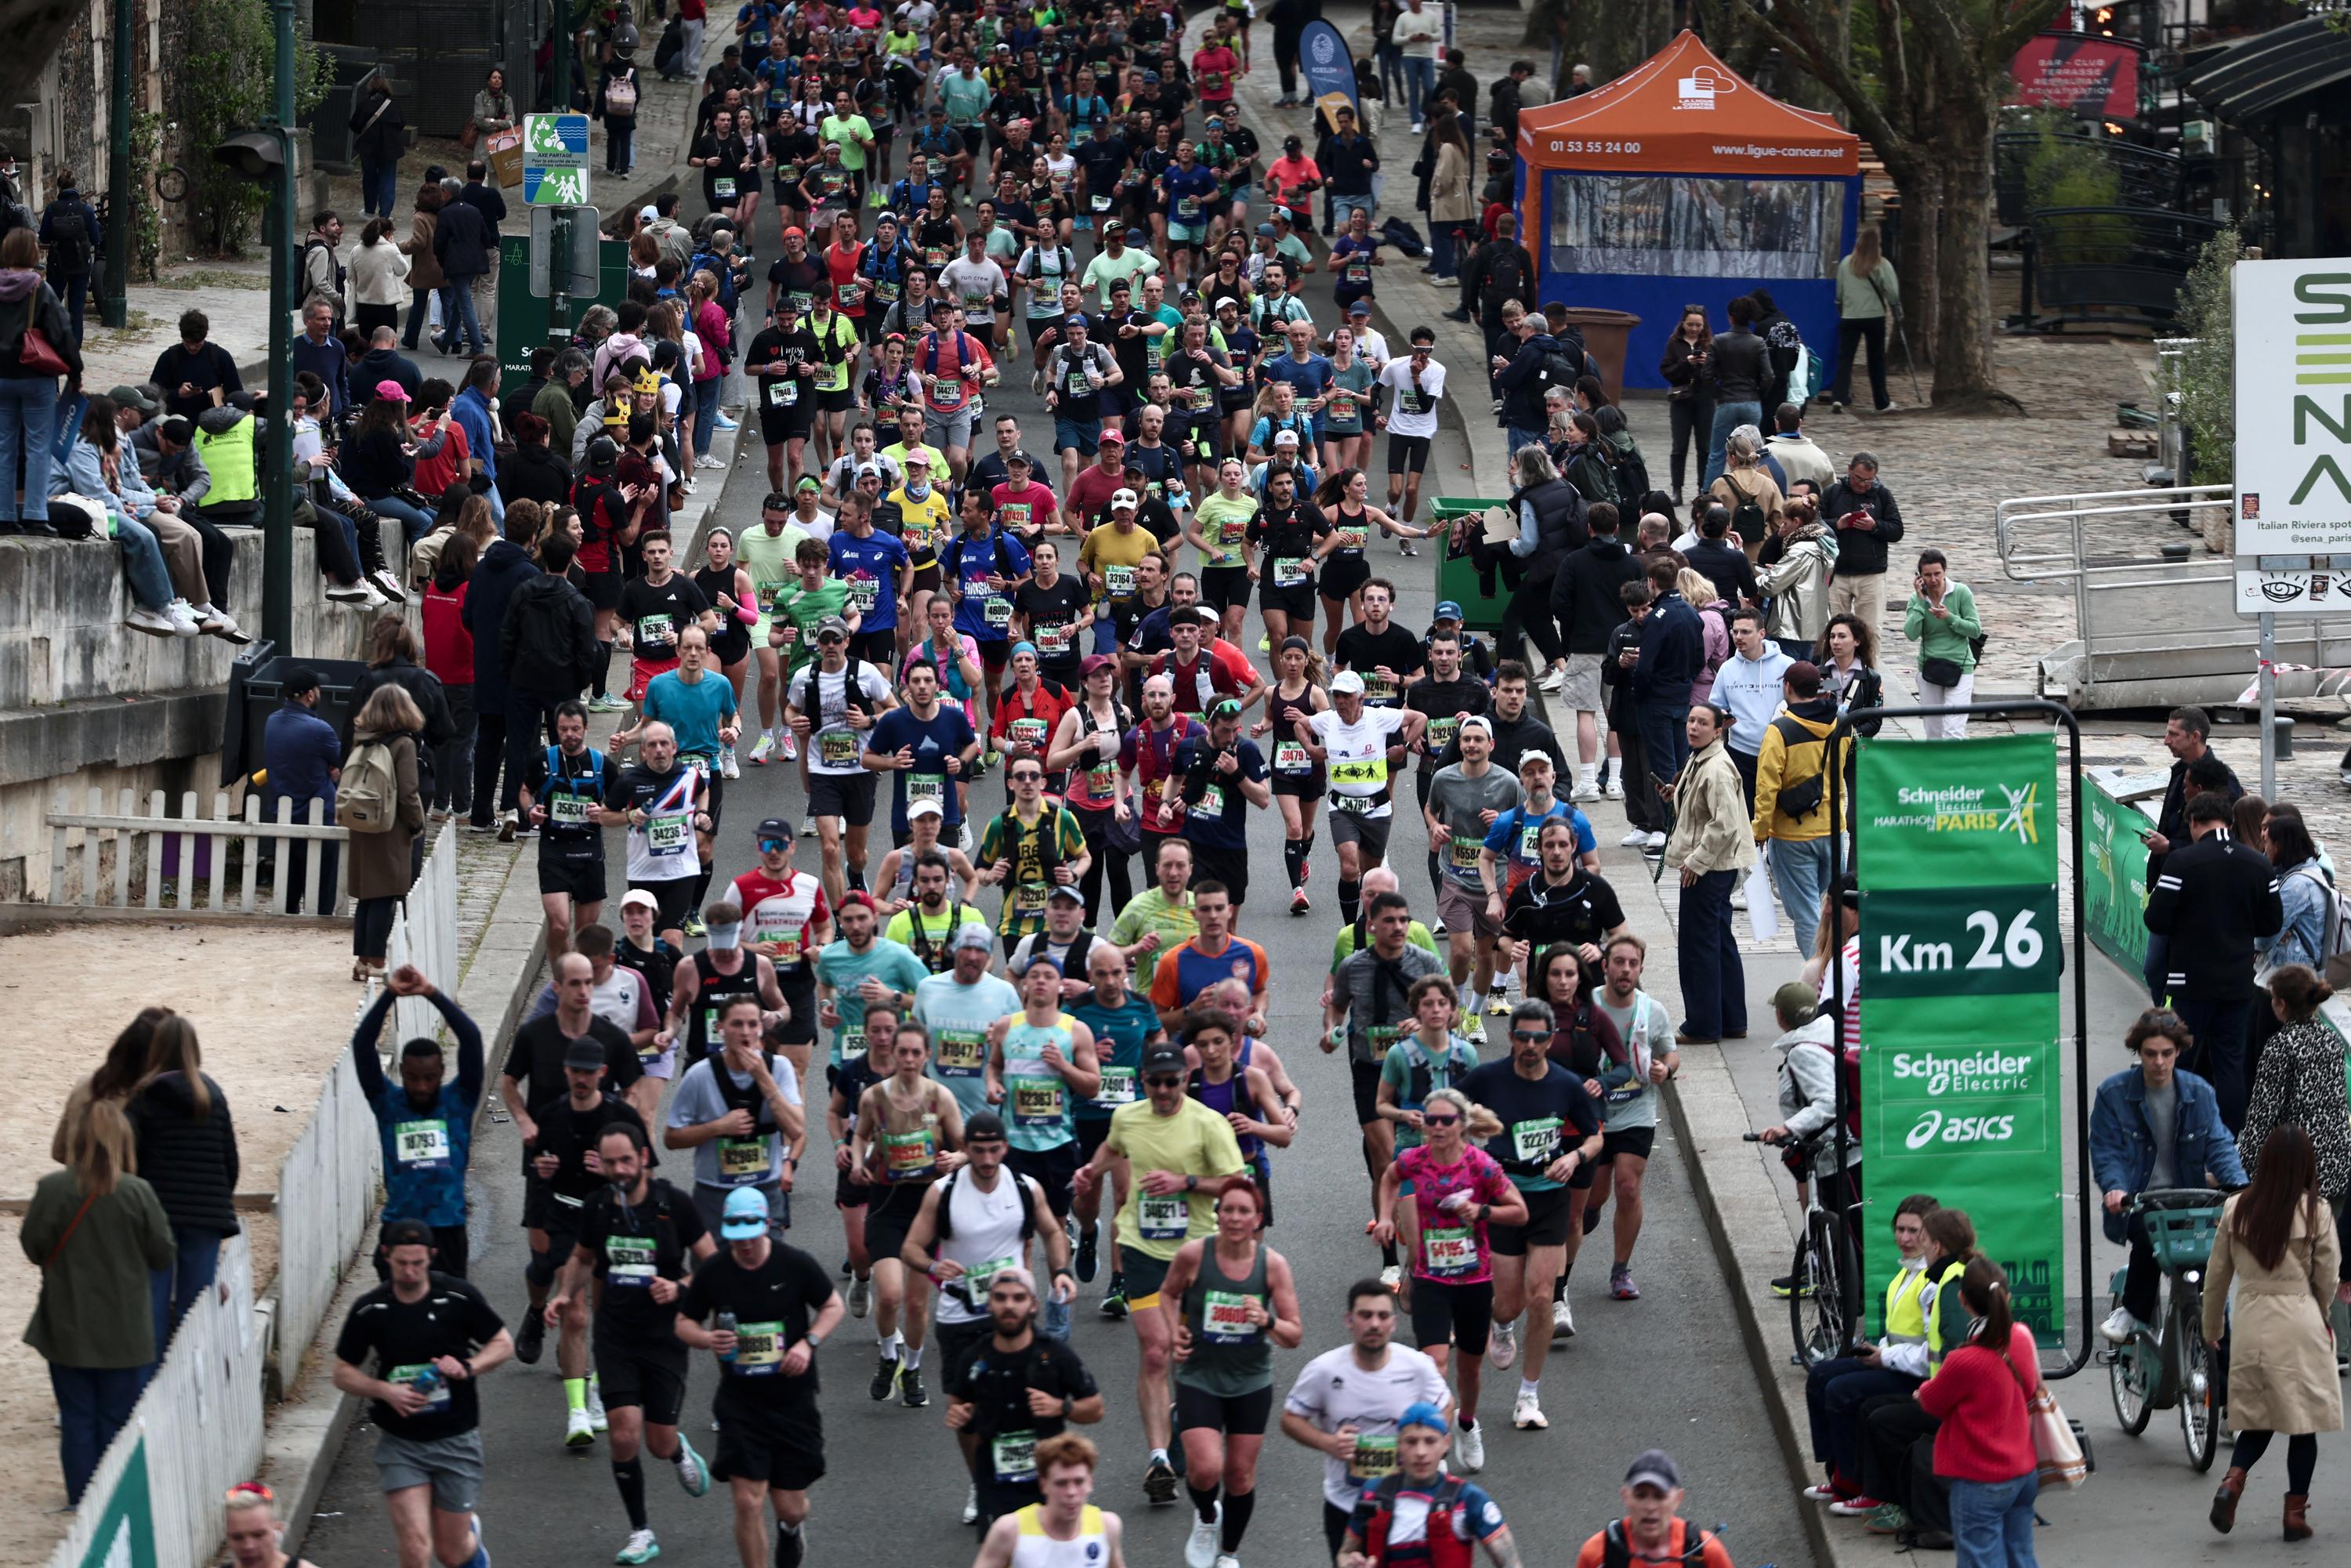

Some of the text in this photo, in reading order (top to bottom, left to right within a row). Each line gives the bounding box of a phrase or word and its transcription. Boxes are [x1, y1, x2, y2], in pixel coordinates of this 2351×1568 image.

[1550, 141, 1641, 154] 01 53 55 24 00
[1712, 144, 1843, 158] www.ligue-cancer.net
[786, 346, 804, 357] miss
[937, 386, 955, 395] 34427
[57, 404, 77, 447] HIPRO
[2258, 521, 2288, 530] Italian
[2291, 520, 2326, 529] Riviera
[1109, 573, 1129, 584] 33164
[644, 621, 667, 635] 35385
[825, 741, 850, 753] 27205
[1280, 750, 1303, 762] 38479
[1898, 785, 1985, 805] Schneider
[1875, 814, 1936, 828] MARATHON
[1936, 812, 1998, 832] PARIS
[653, 824, 679, 840] 34236
[1881, 909, 2044, 973] Km 26
[1893, 1050, 2031, 1078] Schneider
[1952, 1075, 2028, 1092] Electric
[1942, 1114, 2015, 1143] asics
